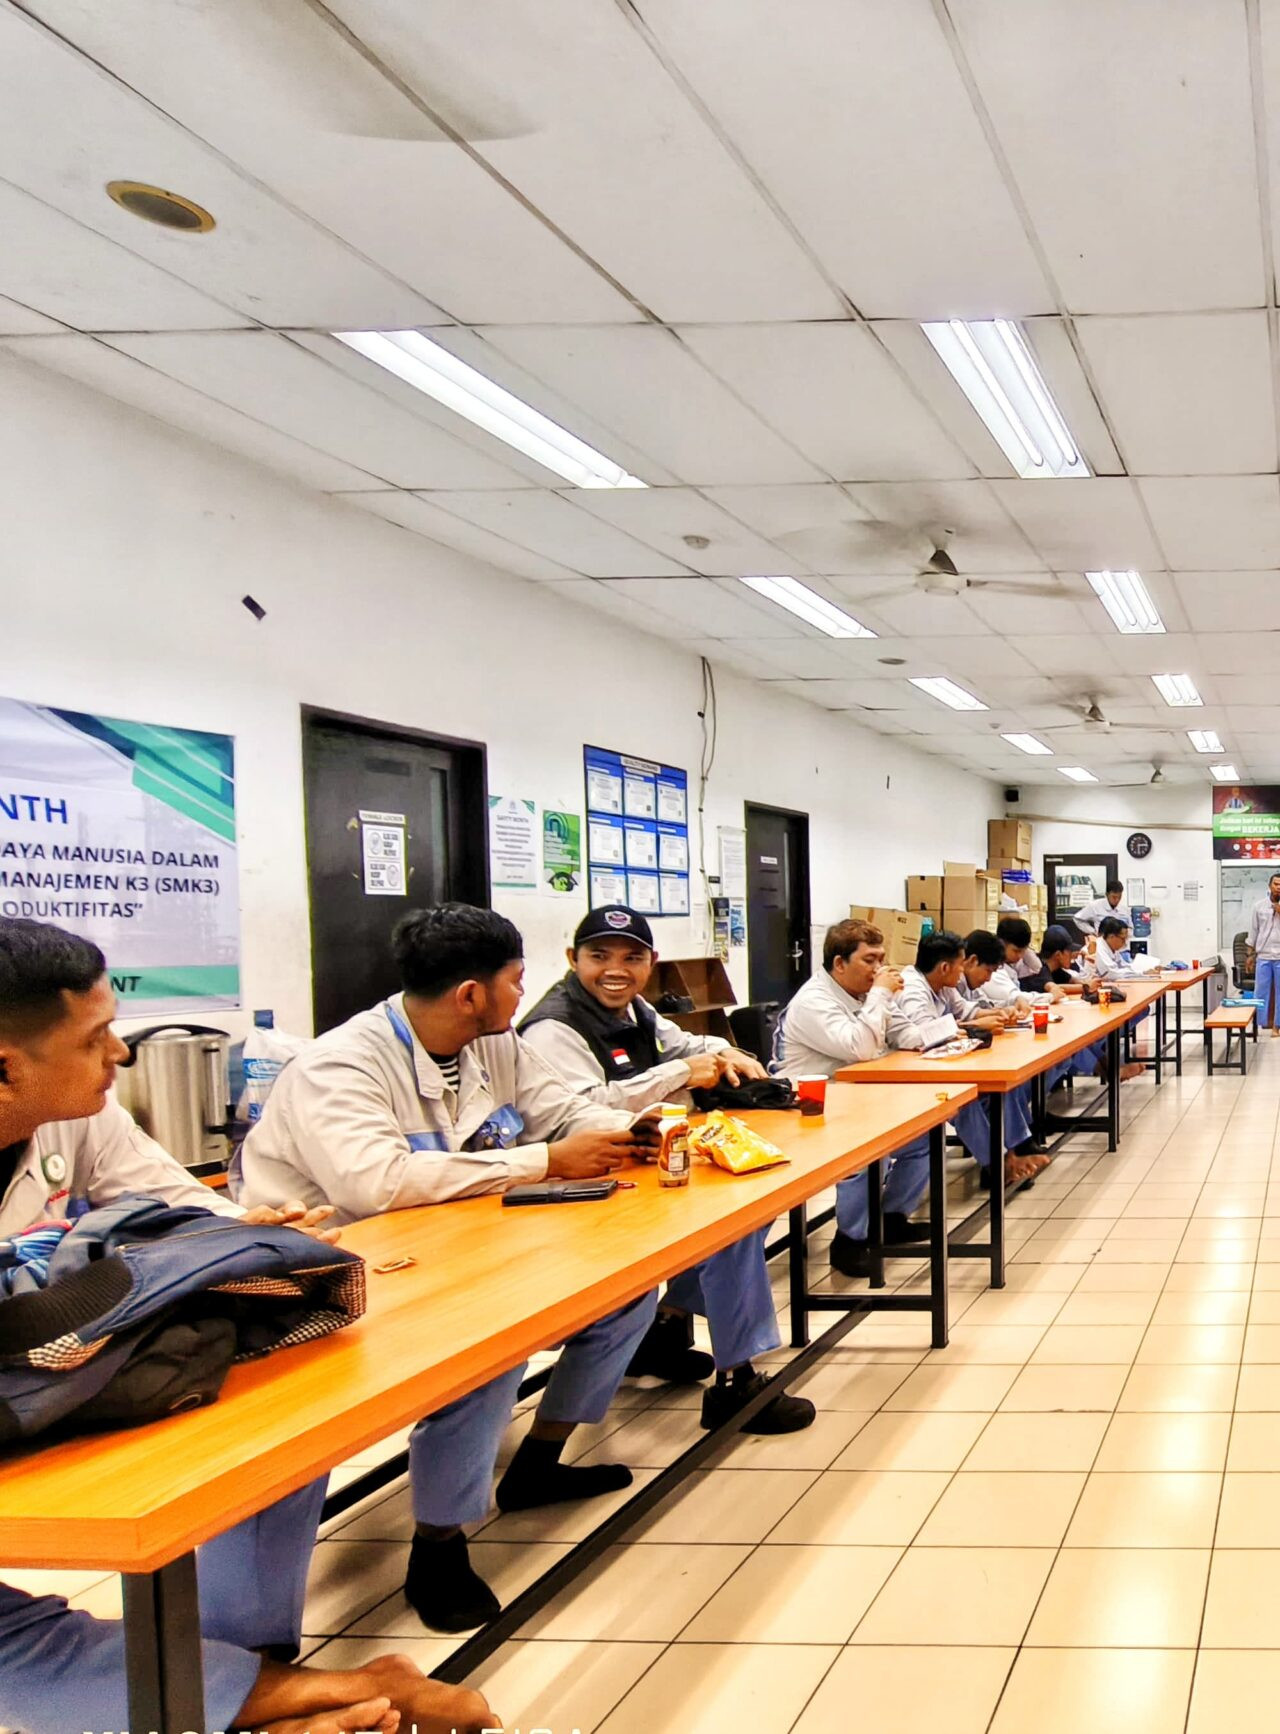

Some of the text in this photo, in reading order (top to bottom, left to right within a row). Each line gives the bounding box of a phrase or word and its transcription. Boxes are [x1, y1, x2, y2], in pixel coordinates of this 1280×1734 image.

[0, 842, 219, 868] AYA MANUSIA DALAM
[126, 877, 149, 891] K3
[155, 877, 220, 896] (SMK3)
